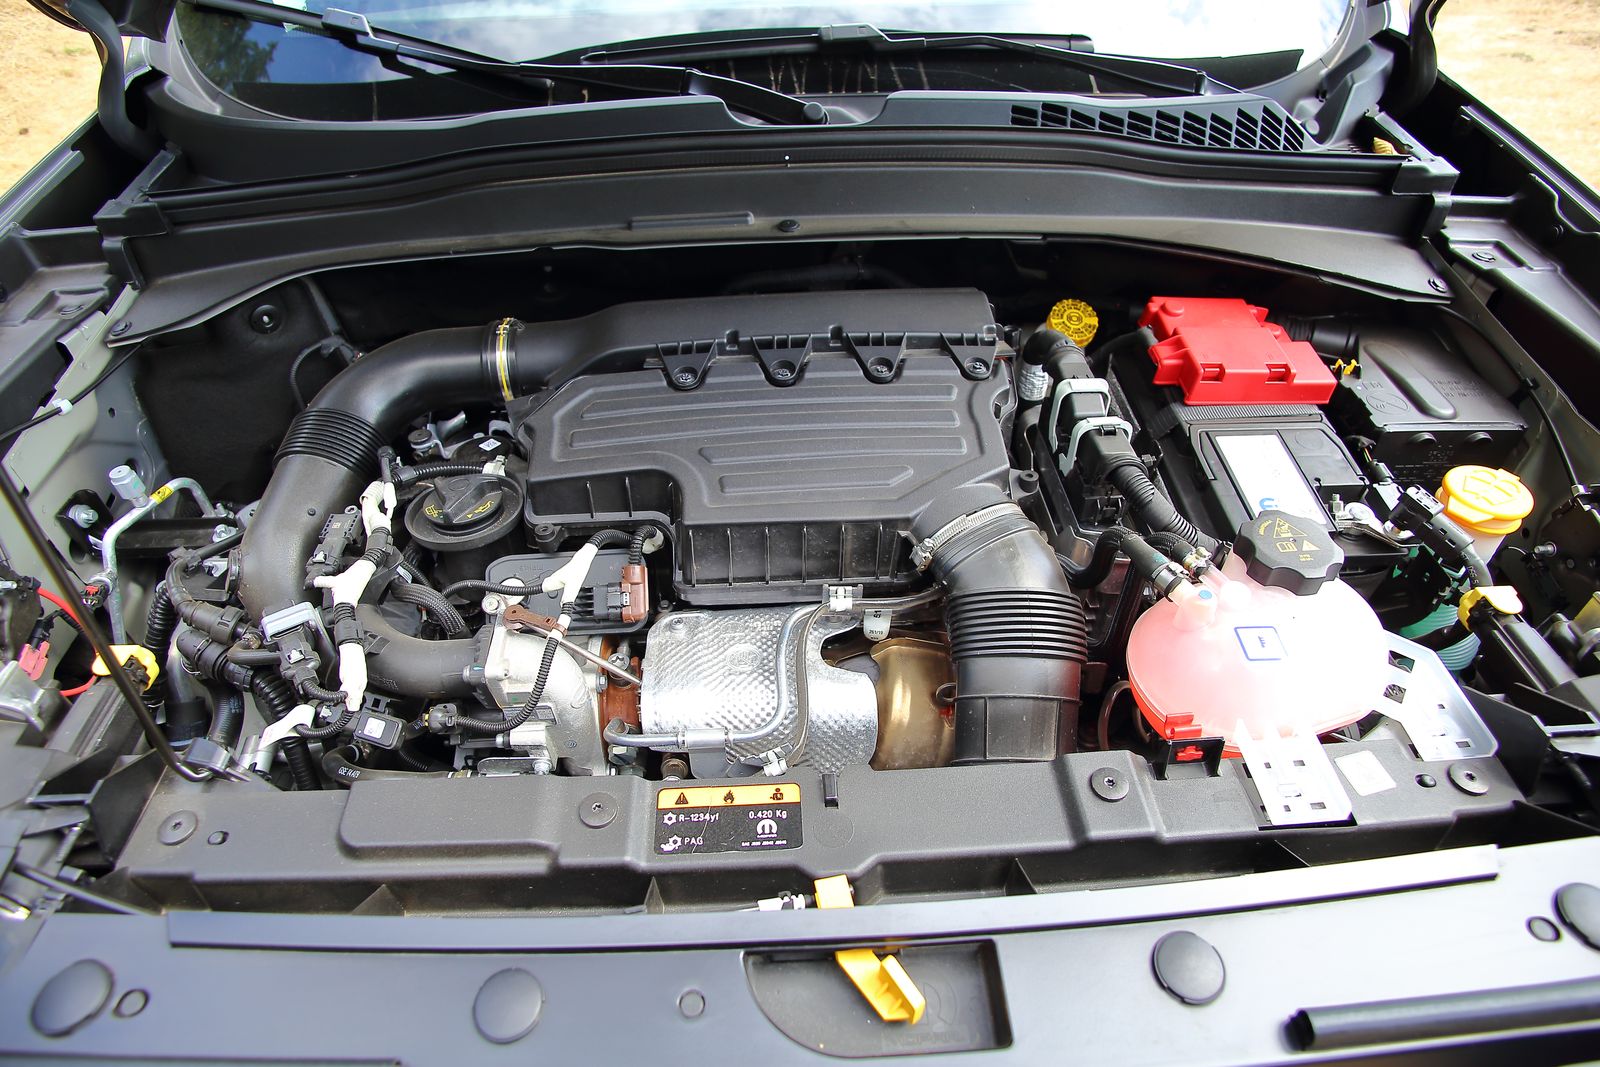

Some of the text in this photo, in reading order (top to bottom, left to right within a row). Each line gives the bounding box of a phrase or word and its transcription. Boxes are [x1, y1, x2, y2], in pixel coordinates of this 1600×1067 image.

[678, 812, 720, 823] R-1234yf
[748, 809, 788, 820] 0.420 Kg
[684, 836, 704, 846] PAG
